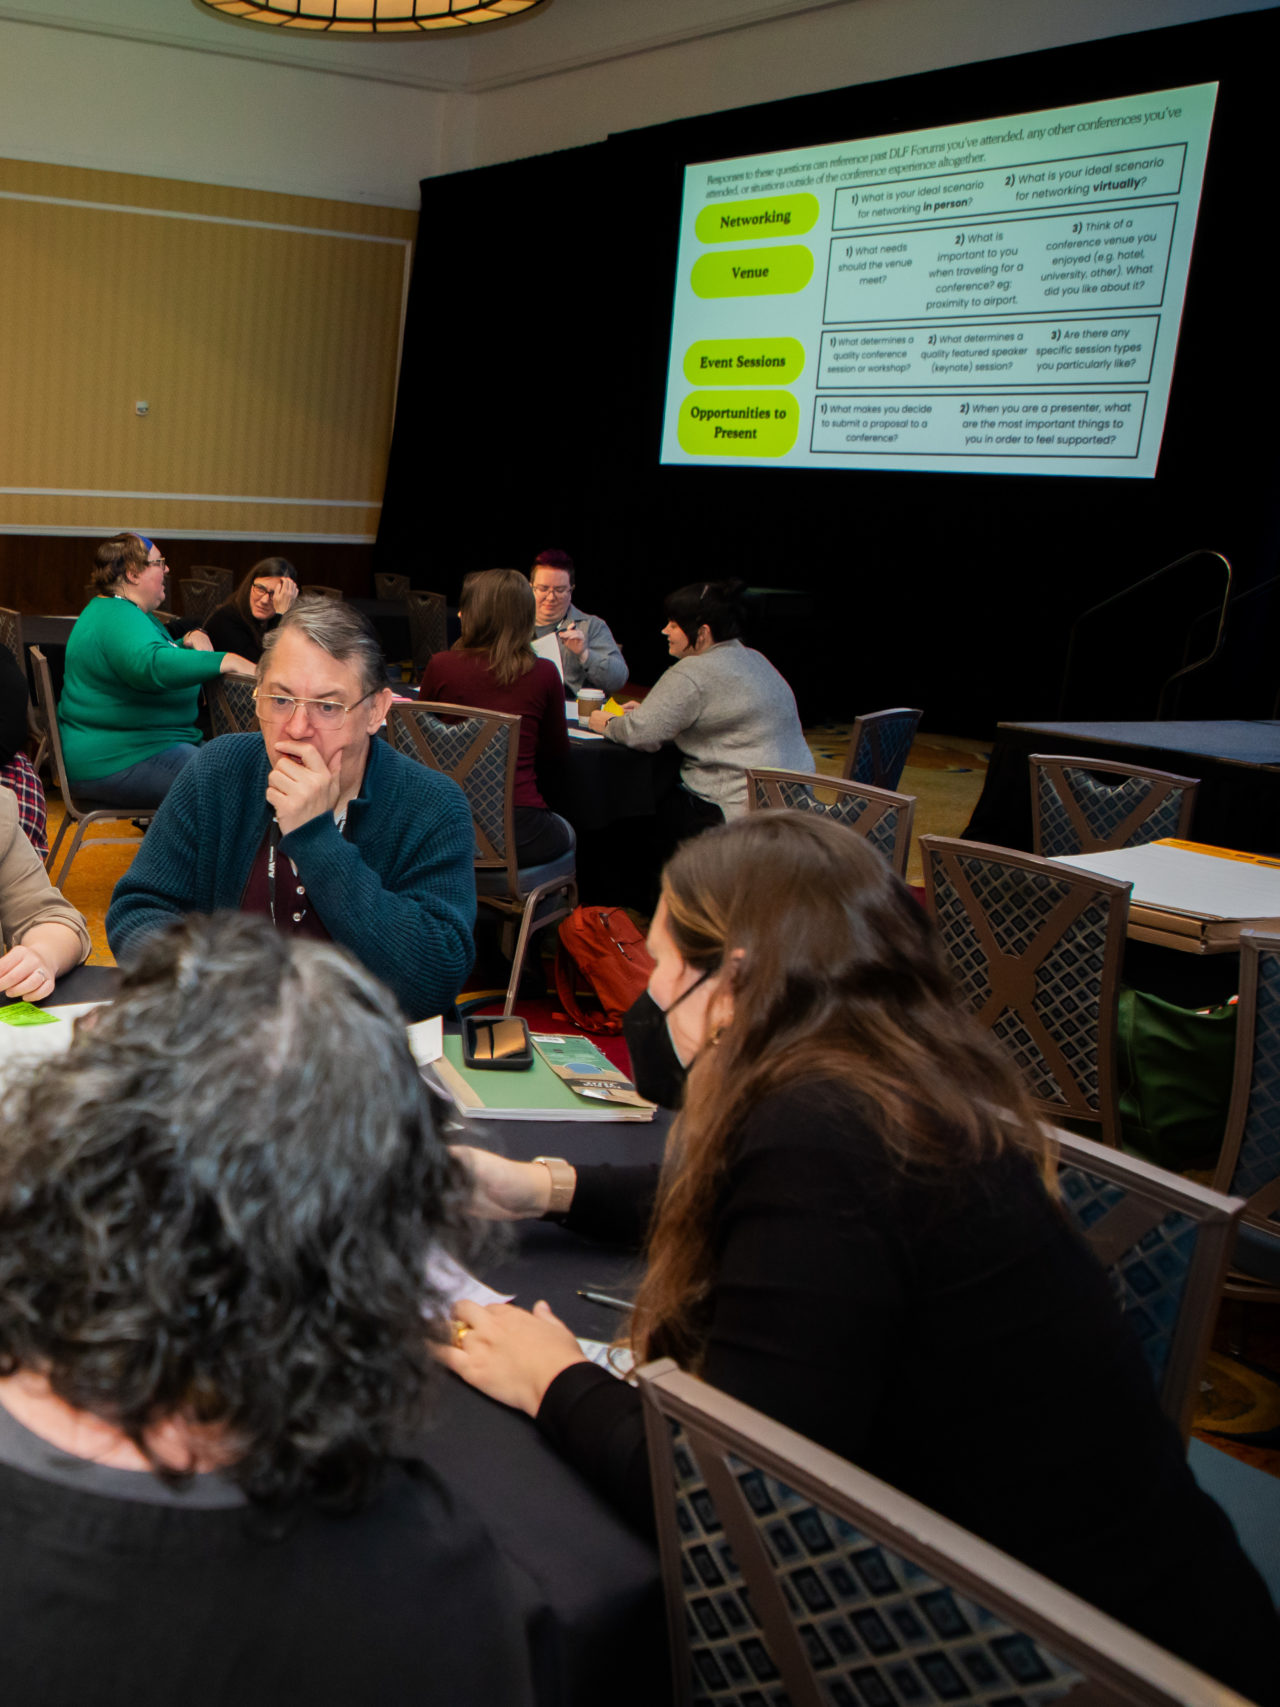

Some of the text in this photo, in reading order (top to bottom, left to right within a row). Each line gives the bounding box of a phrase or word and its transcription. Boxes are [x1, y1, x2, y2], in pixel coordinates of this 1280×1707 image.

[707, 173, 744, 185] Responses
[746, 171, 753, 179] to
[756, 168, 774, 178] these
[776, 163, 812, 176] questions
[814, 160, 828, 169] can
[830, 154, 868, 168] reference
[870, 152, 888, 164] past
[890, 146, 910, 158] DLF
[911, 144, 945, 156] Forums
[946, 138, 977, 152] you've
[1027, 129, 1046, 140] any
[1048, 123, 1074, 136] other
[1077, 114, 1142, 132] conferences
[1144, 106, 1182, 124] you've
[750, 180, 785, 192] situations
[786, 176, 814, 188] outside
[816, 173, 825, 184] of
[825, 172, 838, 182] the
[840, 166, 886, 180] conference
[888, 160, 936, 176] experience
[938, 152, 986, 170] altogether.
[1004, 157, 1164, 186] 2) What is your ideal scenario
[852, 181, 984, 205] 1) What is your ideal scenario
[1016, 177, 1147, 201] for networking virtually?
[858, 197, 973, 219] for networking in person?
[720, 210, 791, 229] Networking
[1072, 219, 1133, 234] 3) Think of a
[955, 232, 1003, 246] 2) What is
[1046, 233, 1157, 251] conference venue you
[846, 243, 907, 258] 1) What needs
[937, 248, 1018, 262] important to you
[838, 260, 912, 272] should the venue
[1052, 253, 1091, 267] enjoyed
[732, 266, 769, 279] Venue
[929, 269, 953, 278] when
[956, 265, 998, 276] traveling
[1001, 264, 1014, 272] for
[1127, 264, 1153, 274] What
[859, 275, 887, 285] meet?
[936, 280, 995, 293] conference?
[1044, 281, 1145, 297] did you like about it?
[926, 299, 969, 310] proximity
[971, 298, 981, 306] to
[830, 337, 836, 347] 1)
[838, 337, 858, 346] What
[861, 336, 906, 345] determines
[928, 333, 1023, 345] 2) What determines a
[1051, 329, 1130, 341] 3) Are there any
[833, 350, 907, 360] quality conference
[921, 347, 1028, 360] quality featured speaker
[1036, 344, 1141, 356] specific session types
[700, 355, 786, 369] Event Sessions
[827, 364, 856, 373] session
[867, 363, 911, 374] workshop?
[931, 361, 1014, 374] (keynote) session?
[1036, 358, 1136, 372] you particularly like?
[691, 406, 786, 421] Opportunities to
[821, 404, 932, 415] 1) What makes you decide
[960, 403, 970, 415] 2)
[972, 404, 999, 413] When
[1002, 405, 1019, 415] you
[1050, 403, 1101, 415] presenter,
[1105, 402, 1131, 412] what
[822, 419, 830, 427] to
[832, 419, 861, 428] submit
[870, 419, 909, 430] proposal
[910, 419, 920, 428] to
[962, 418, 1123, 431] are the most important things to
[714, 426, 757, 439] Present
[846, 433, 898, 442] conference?
[965, 434, 1116, 445] you in order to feel supported?
